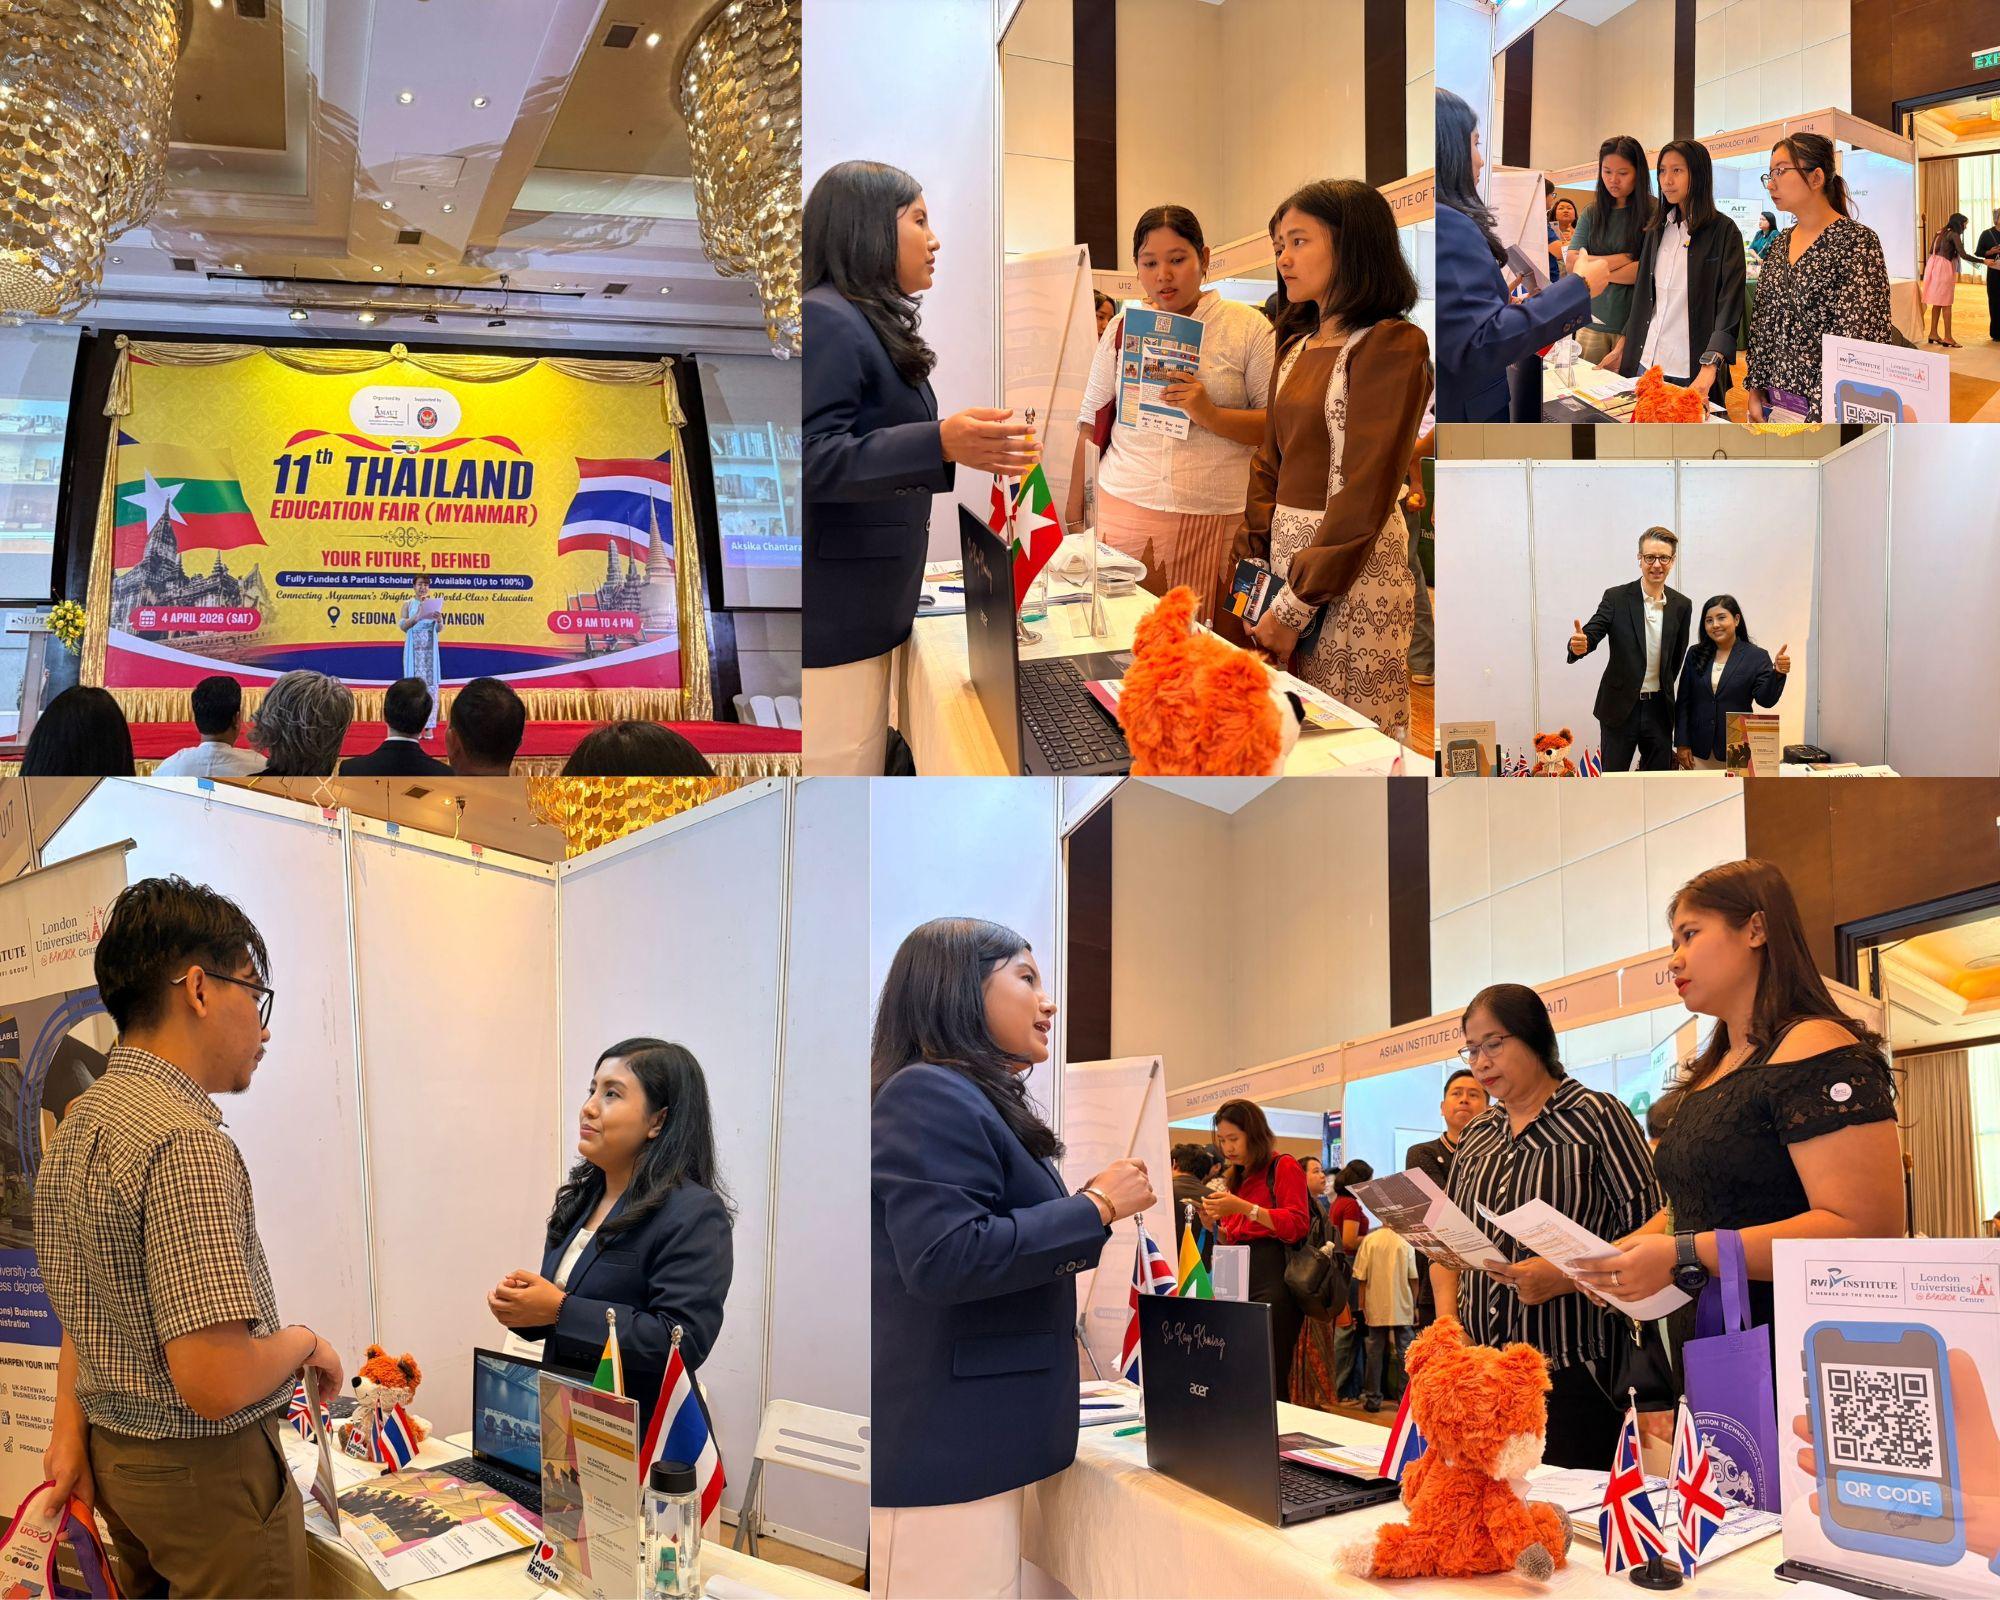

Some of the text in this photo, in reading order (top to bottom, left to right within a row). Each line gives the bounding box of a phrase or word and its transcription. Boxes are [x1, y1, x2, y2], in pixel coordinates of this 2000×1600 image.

[1975, 52, 2000, 69] EXI
[1802, 124, 1814, 132] U14
[1709, 135, 1760, 150] TECHNOLOGY (AIT)
[1415, 189, 1428, 203] OF
[1118, 282, 1132, 290] U12
[272, 448, 534, 500] 11th THAILAND
[270, 500, 538, 527] EDUCATION FAIR (MYANMAR)
[731, 542, 761, 550] Aksika
[322, 550, 490, 572] YOUR FUTURE, DEFINED
[285, 574, 306, 584] Fully
[308, 575, 340, 584] Funded
[342, 576, 348, 584] &
[350, 576, 378, 584] Partial
[434, 577, 472, 586] Available
[474, 578, 488, 588] (Up
[490, 578, 498, 586] to
[500, 578, 524, 588] 100%)
[276, 590, 322, 600] Connecting
[492, 592, 534, 602] Education
[161, 612, 254, 625] 4 APRIL 2026 (SAT)
[352, 612, 485, 626] SEDONA YANGON
[576, 618, 634, 628] 9 AM TO 4 PM
[42, 917, 78, 935] London
[36, 930, 87, 952] Universities
[10, 966, 28, 975] GROUP
[1380, 1044, 1404, 1058] ASIAN
[1406, 1030, 1450, 1052] INSTITUTE
[1312, 1063, 1325, 1074] U13
[1186, 1096, 1200, 1106] SAINT
[1220, 1082, 1250, 1099] UNIVERSITY
[1920, 1273, 1960, 1282] London
[14, 1280, 44, 1295] degree
[1843, 1280, 1898, 1290] INSTITUTE
[1910, 1282, 1971, 1293] Universities
[14, 1307, 48, 1318] Business
[24, 1360, 44, 1370] YOUR
[12, 1391, 38, 1400] BUSINESS
[20, 1385, 46, 1394] PATHWAY
[1189, 1382, 1210, 1398] acer
[16, 1420, 47, 1430] INTERNSHIP
[20, 1444, 48, 1454] PROBLEM-
[1844, 1480, 1932, 1506] QR CODE
[534, 1540, 543, 1556] I
[526, 1564, 542, 1580] Met
[530, 1555, 558, 1580] London
